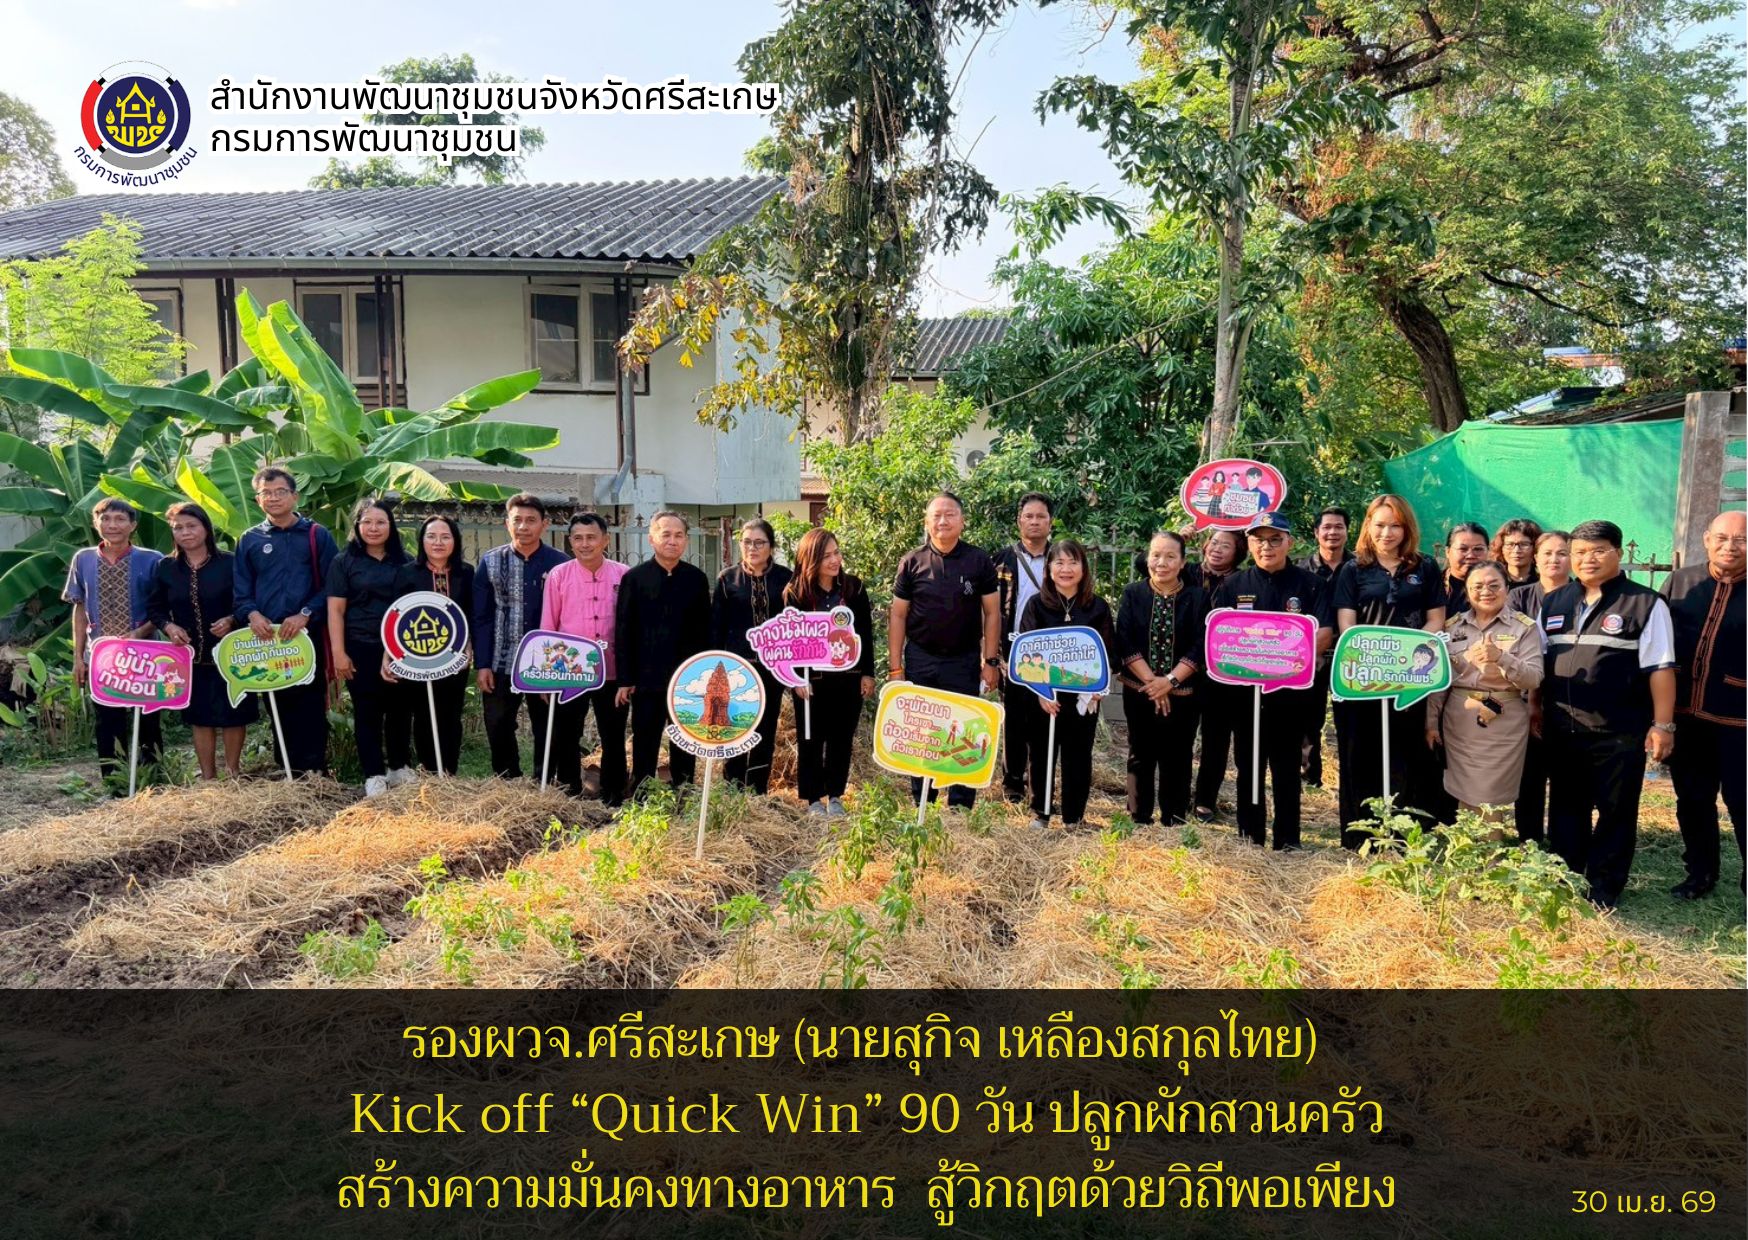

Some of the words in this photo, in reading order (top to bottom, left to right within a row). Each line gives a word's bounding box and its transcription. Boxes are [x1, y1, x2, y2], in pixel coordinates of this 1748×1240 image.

[749, 609, 830, 648] ทางนี้มีผล
[1020, 634, 1077, 653] ภาคีทำช่วย
[1351, 635, 1401, 653] ปลูกพืช
[115, 647, 156, 677] ผู้นำ
[98, 670, 157, 696] ทำก่อน
